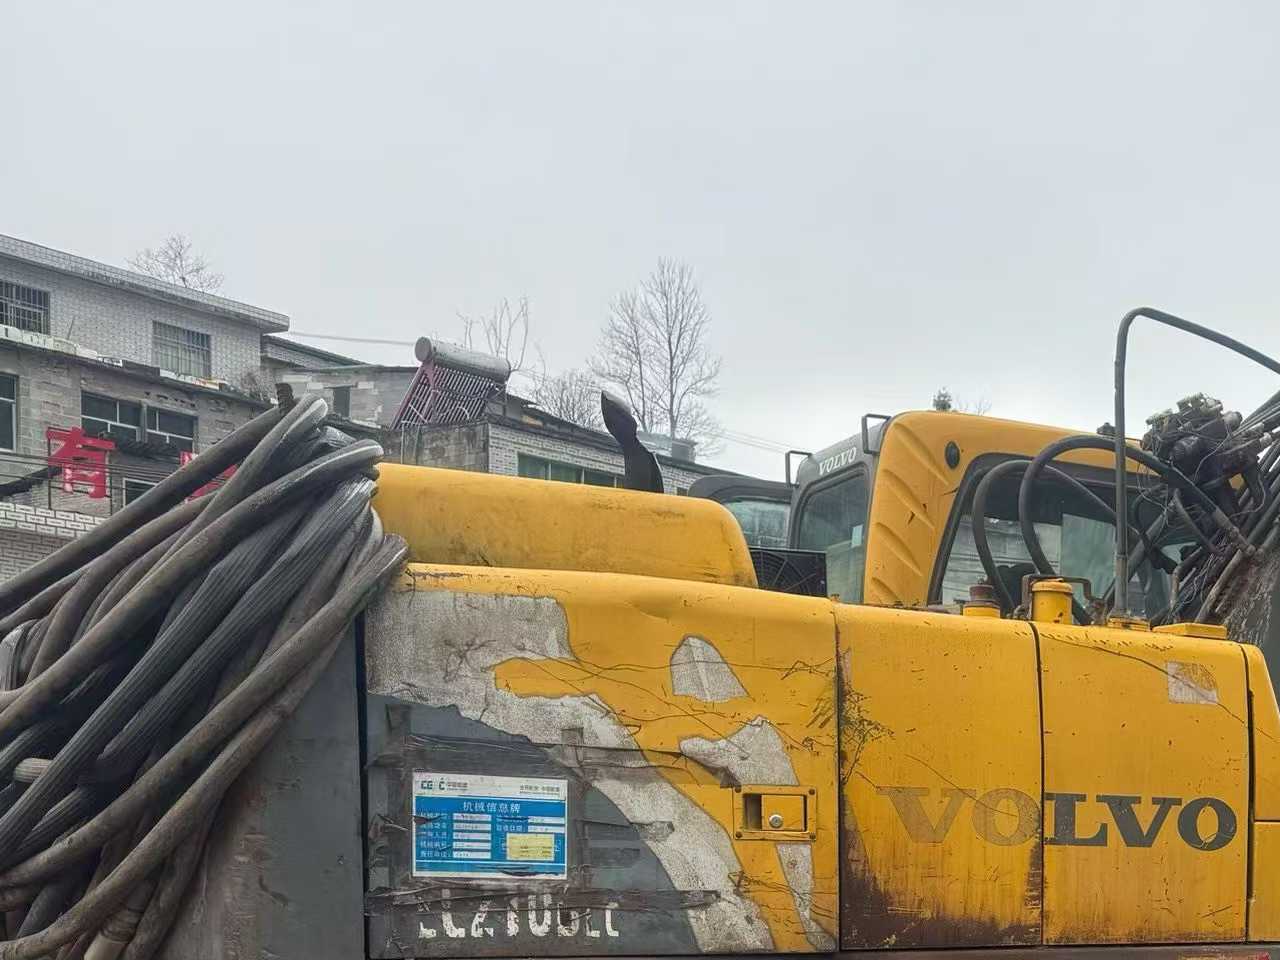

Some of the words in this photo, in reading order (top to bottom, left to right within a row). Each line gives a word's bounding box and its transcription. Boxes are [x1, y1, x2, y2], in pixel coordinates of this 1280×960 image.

[819, 446, 857, 476] VOLVO
[463, 801, 521, 813] 机械信息牌
[876, 787, 1238, 851] VOLVO
